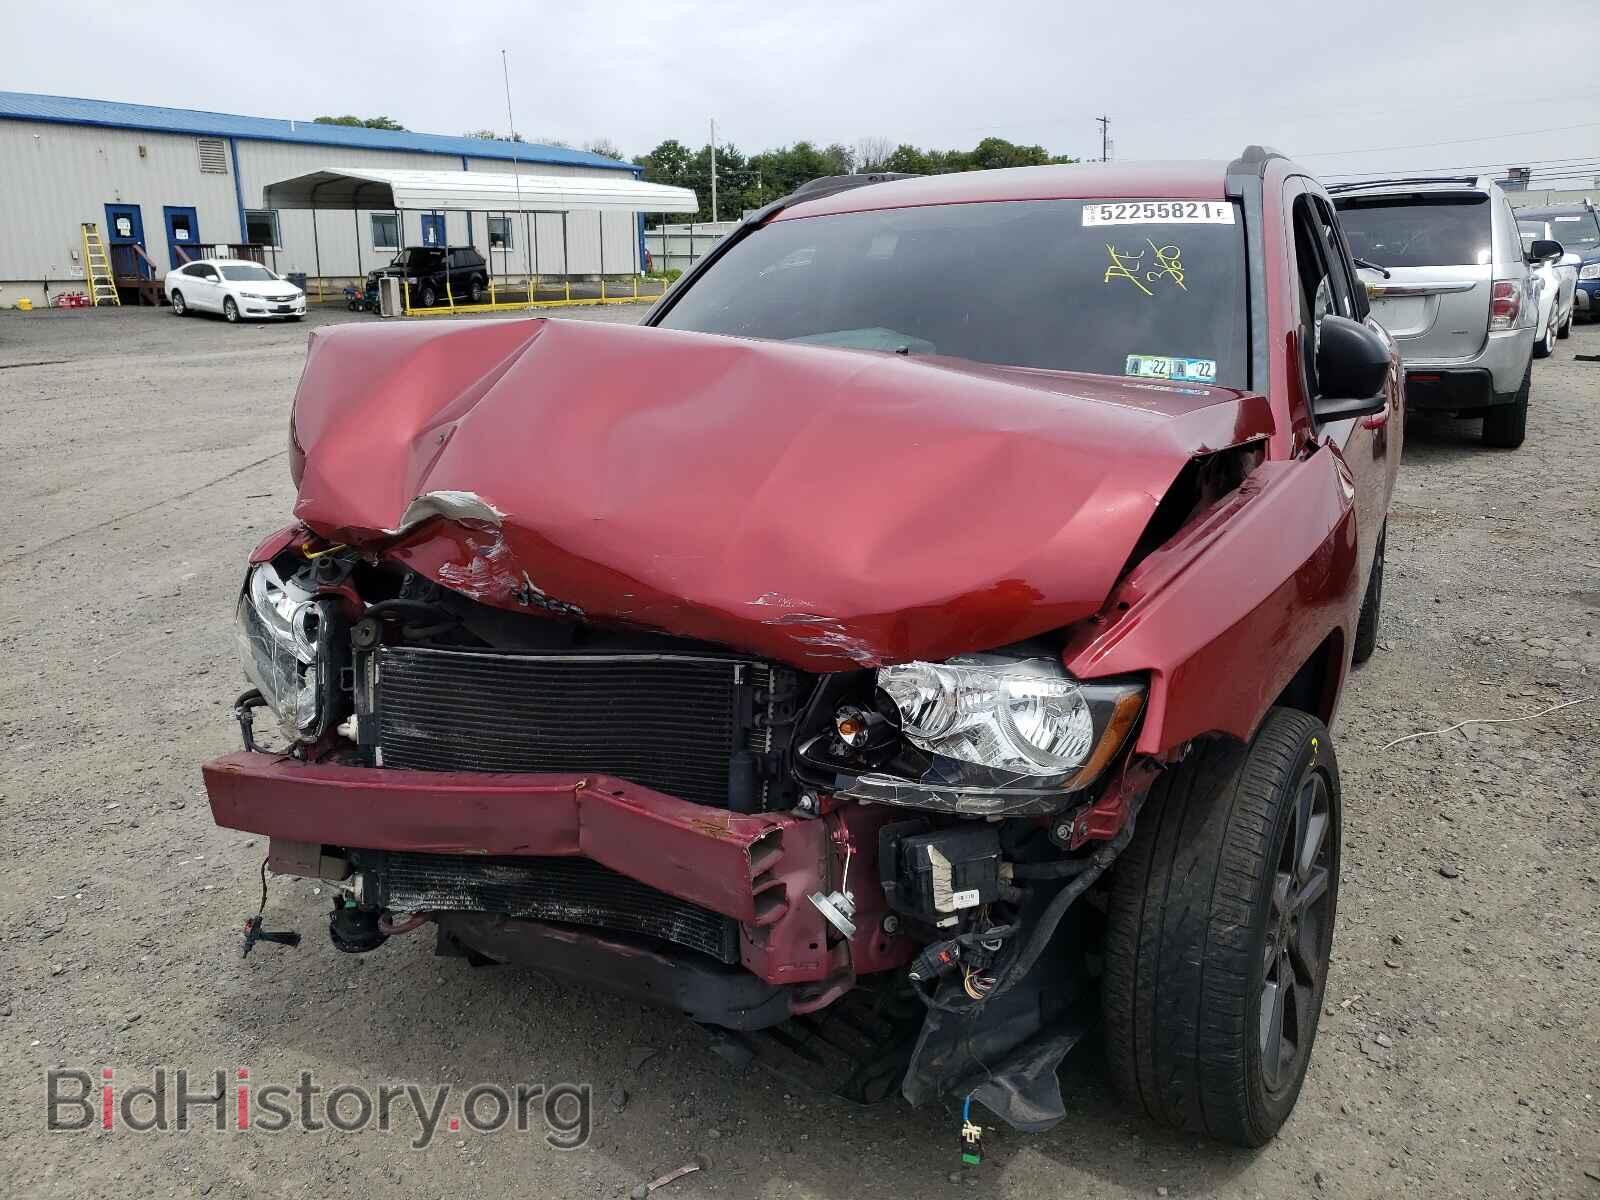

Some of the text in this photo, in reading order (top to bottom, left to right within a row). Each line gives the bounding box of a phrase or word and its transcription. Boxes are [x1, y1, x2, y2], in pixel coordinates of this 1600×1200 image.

[1100, 203, 1211, 220] 52255821
[1152, 359, 1166, 375] 22
[1198, 362, 1211, 377] 22
